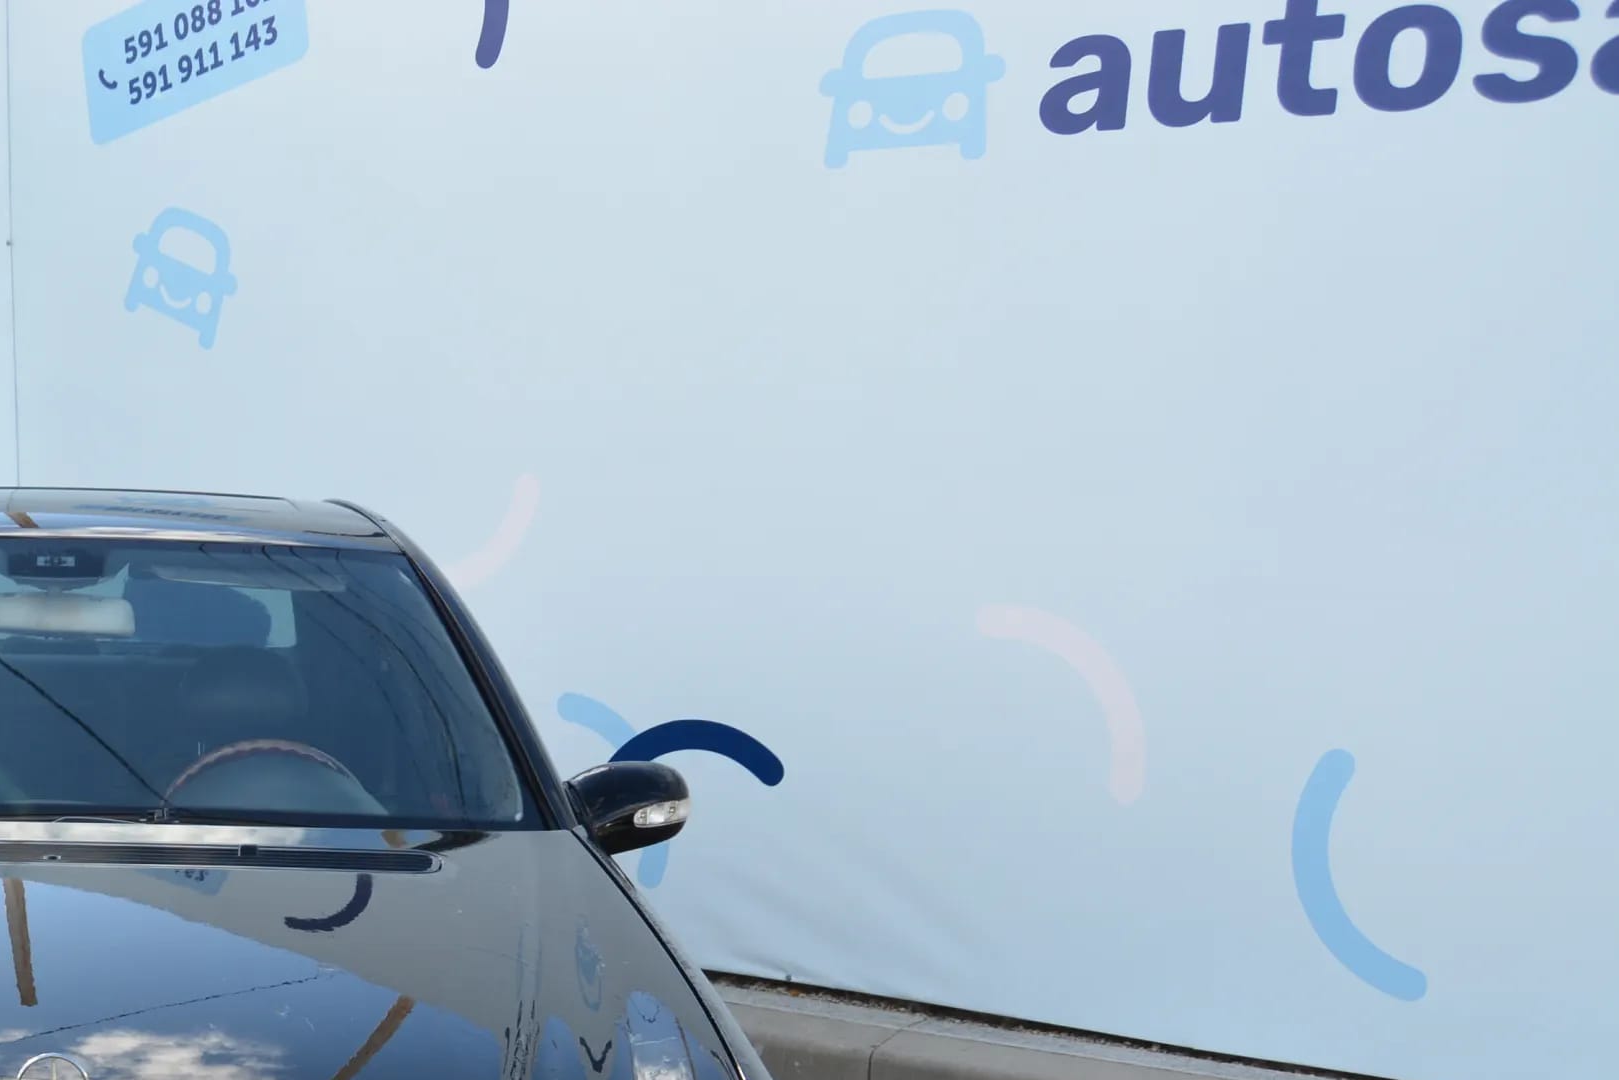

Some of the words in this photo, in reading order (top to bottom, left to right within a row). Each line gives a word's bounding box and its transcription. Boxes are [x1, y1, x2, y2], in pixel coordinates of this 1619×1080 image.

[124, 22, 168, 65] 591
[174, 0, 222, 41] 088
[128, 64, 173, 105] 591
[177, 41, 224, 84] 911
[229, 15, 278, 62] 143
